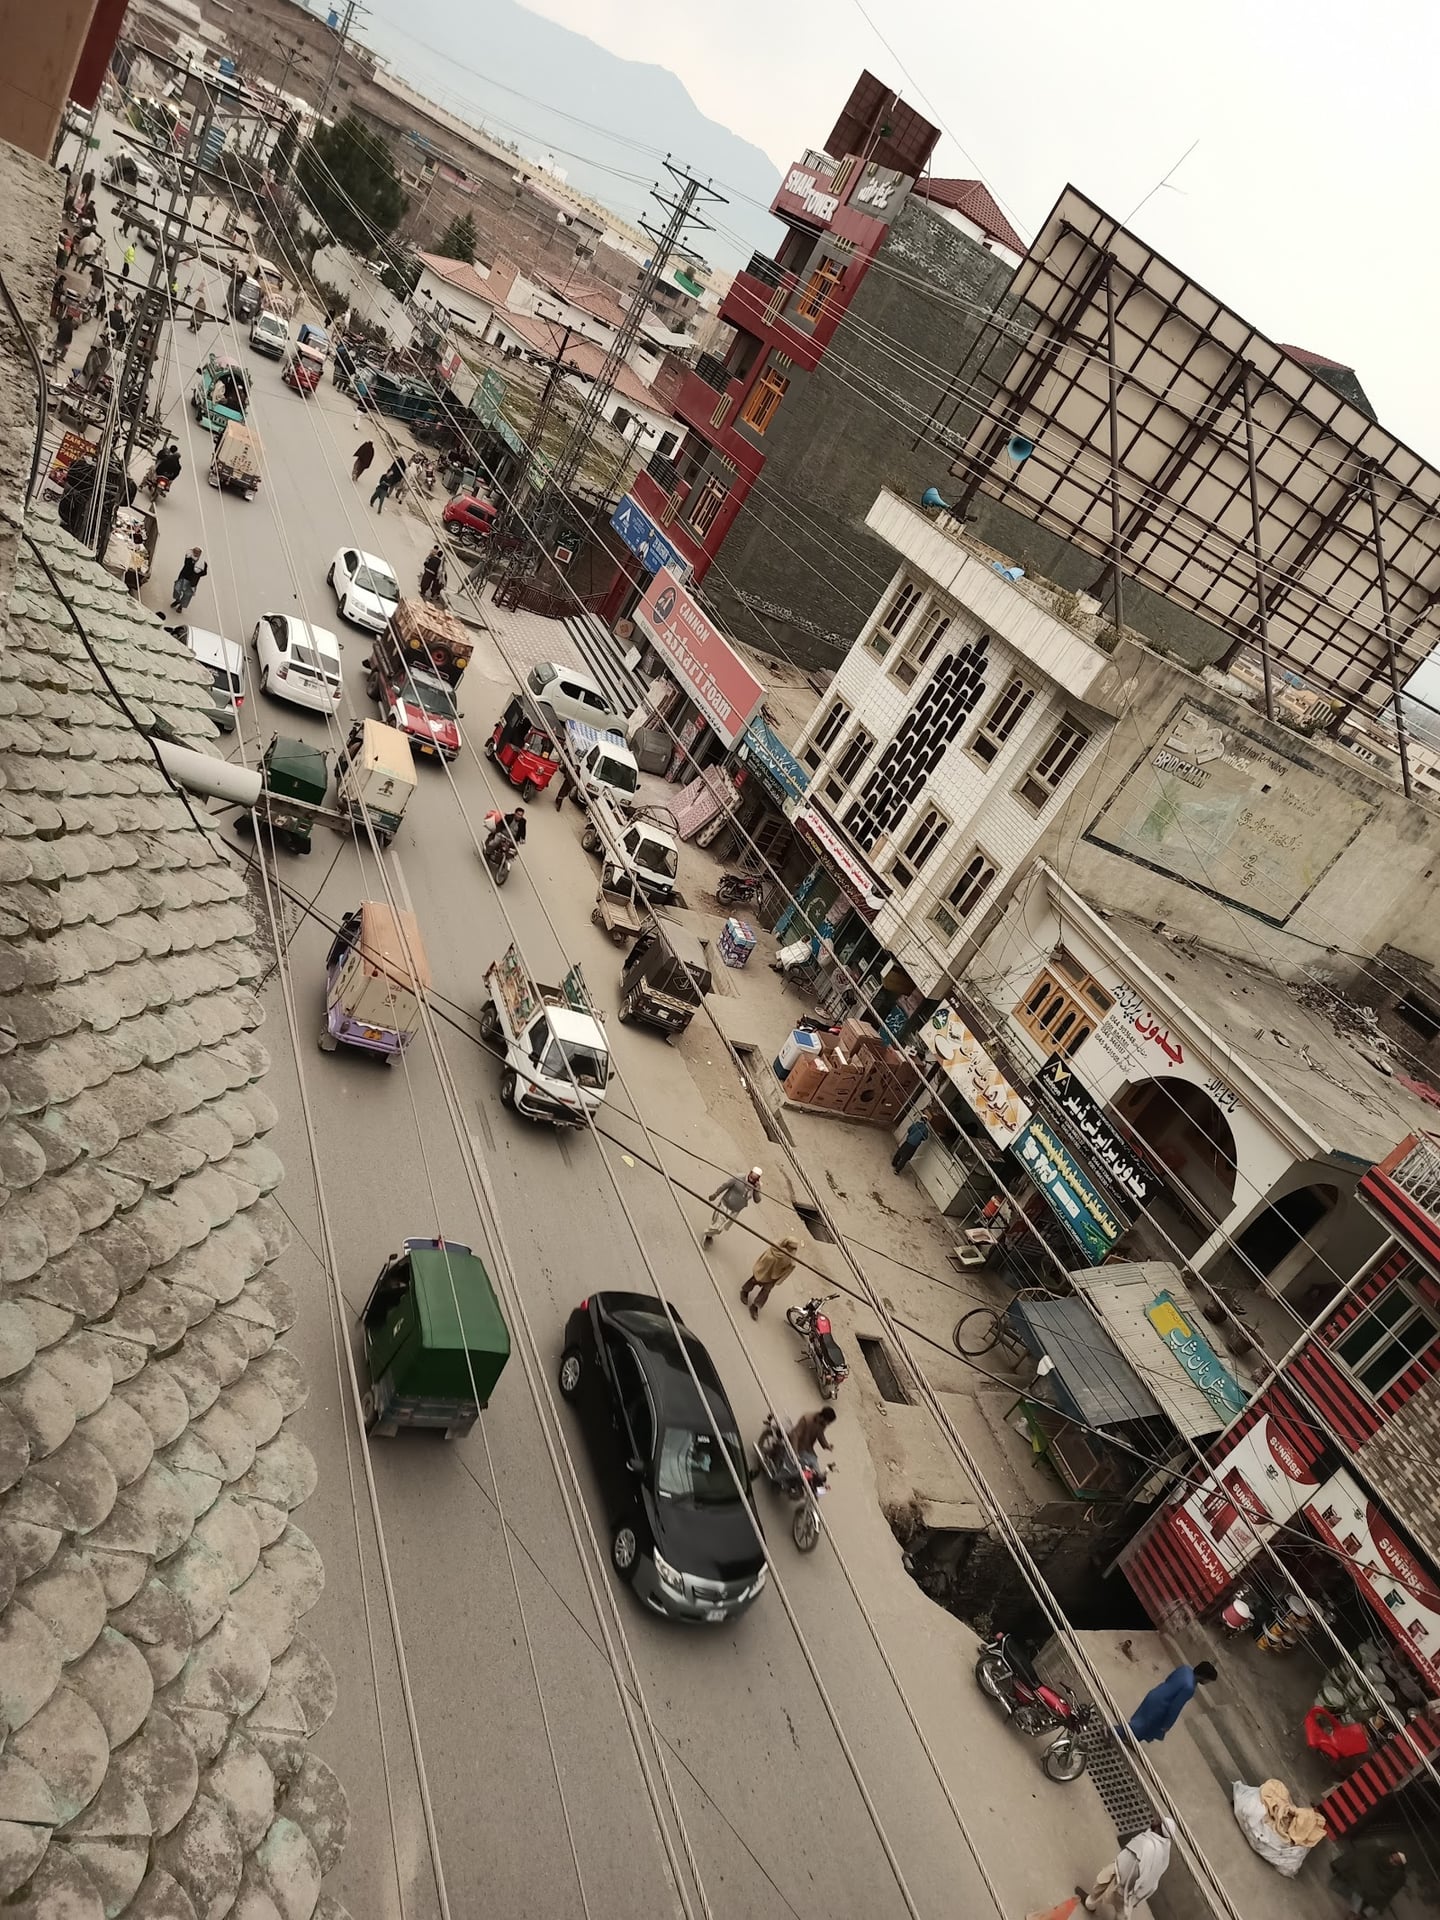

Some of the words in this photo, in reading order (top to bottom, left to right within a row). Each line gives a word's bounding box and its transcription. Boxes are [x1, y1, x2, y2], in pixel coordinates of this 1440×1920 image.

[784, 168, 816, 198] SHAH
[801, 188, 840, 221] TOWER
[677, 602, 711, 642] CANNON
[1152, 749, 1211, 789] BRIDGEMAN
[1133, 1009, 1182, 1067] جدون
[1110, 1155, 1146, 1199] جدون
[1169, 1328, 1197, 1356] شاپ
[1188, 1350, 1211, 1374] نان
[1268, 1436, 1303, 1478] SUNRISE
[1174, 1517, 1199, 1542] کمپنی
[1377, 1537, 1427, 1596] SUNRISE
